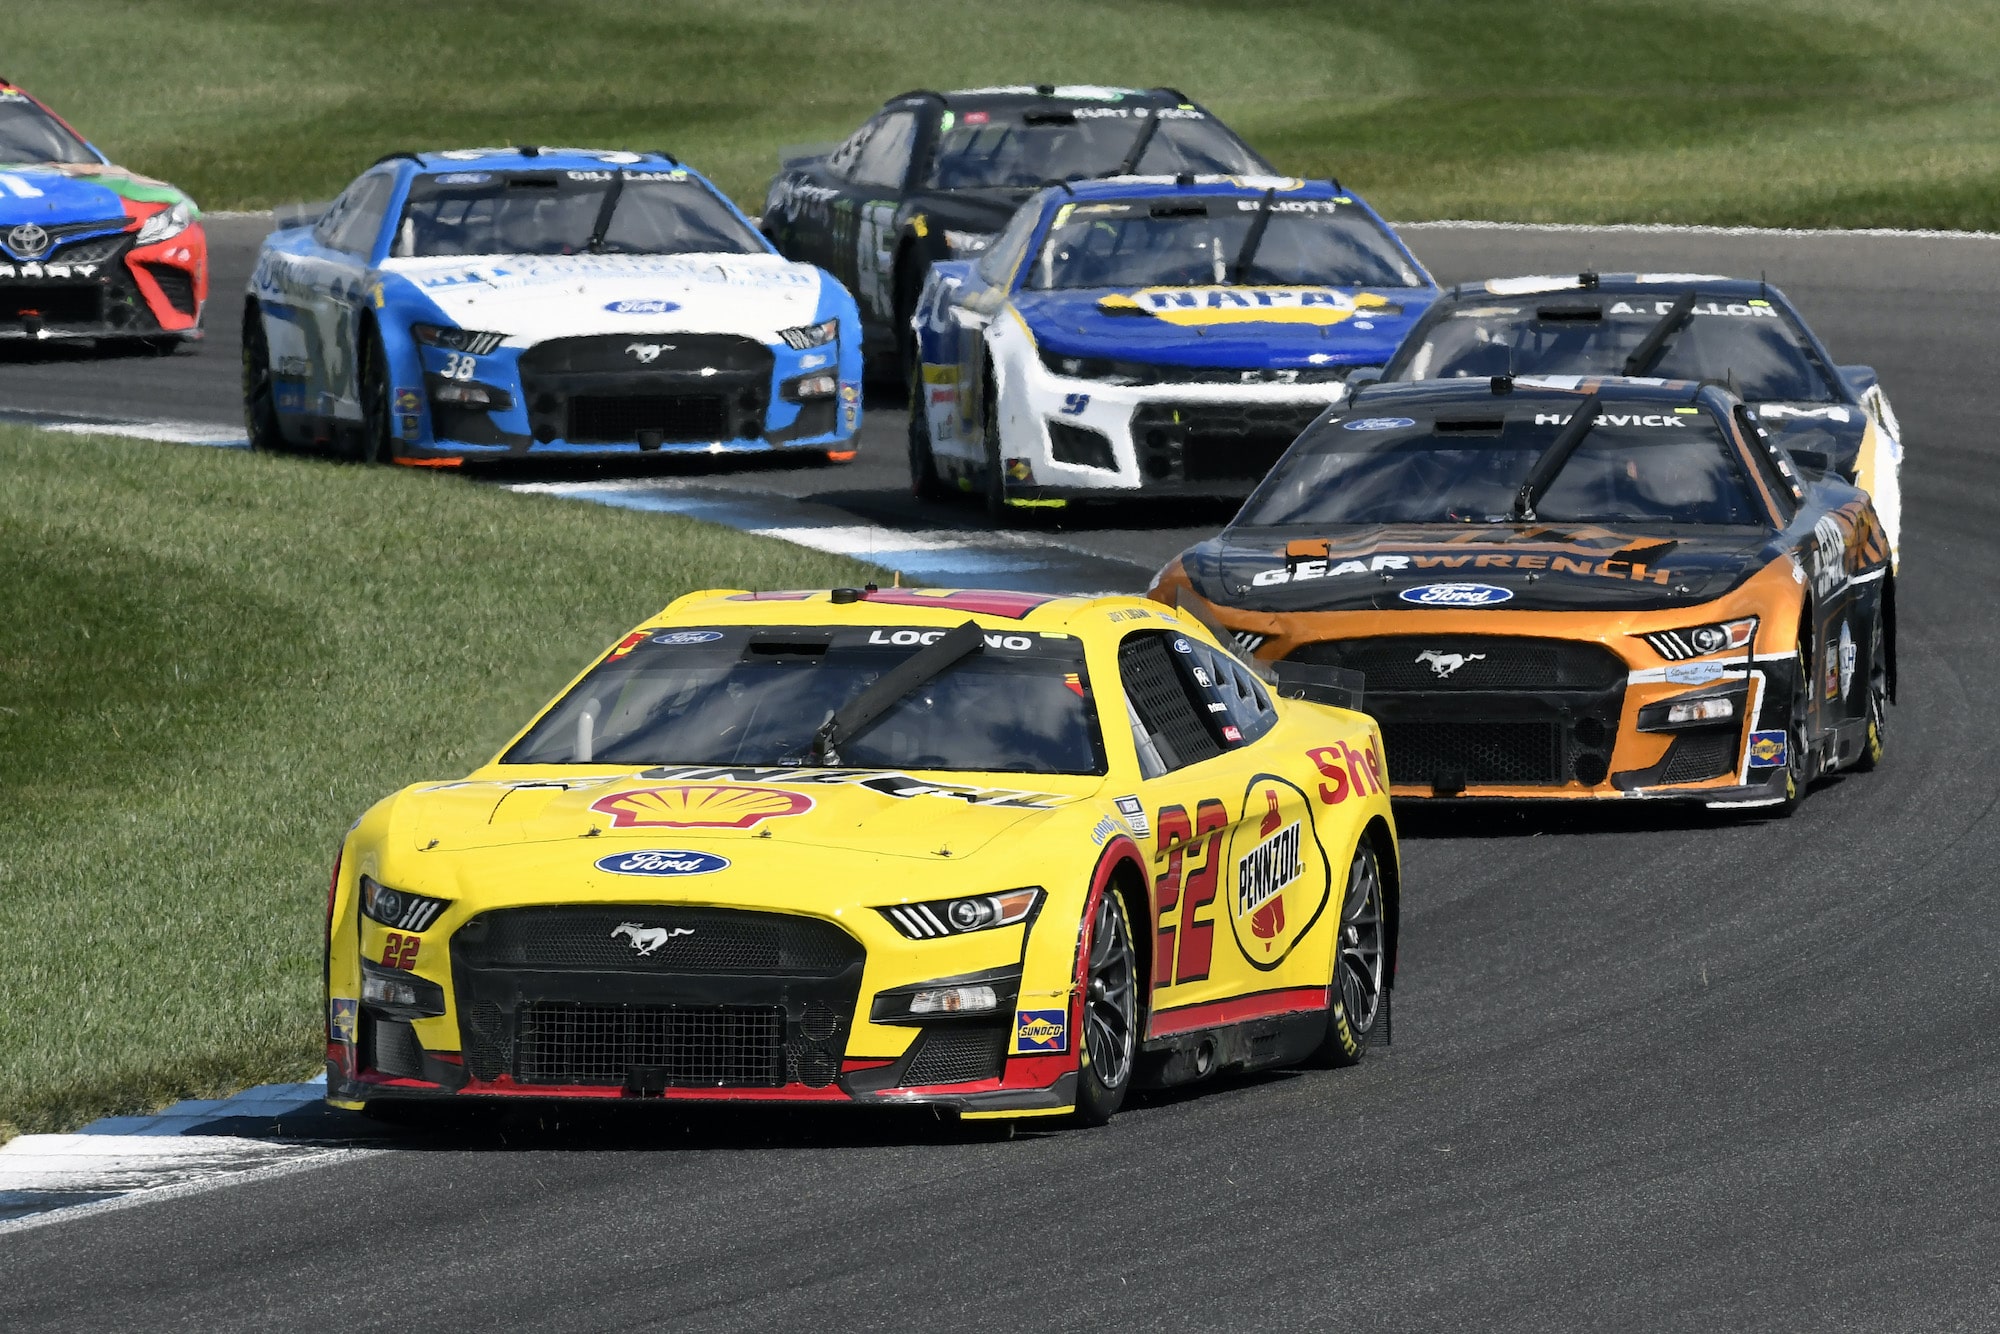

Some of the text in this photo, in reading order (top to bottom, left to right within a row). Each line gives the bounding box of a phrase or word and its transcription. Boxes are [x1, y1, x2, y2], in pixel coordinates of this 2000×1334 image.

[1150, 290, 1340, 309] NAPA
[1655, 302, 1778, 317] DLLON
[440, 353, 476, 382] 38
[1061, 393, 1090, 416] 9
[1252, 555, 1671, 587] GEARWRENCH
[868, 630, 1032, 651] LOGNO
[619, 851, 705, 872] Ford
[1238, 822, 1301, 918] PENNZOIL
[1154, 798, 1229, 988] 22
[382, 932, 421, 971] 22
[1020, 1024, 1062, 1037] SUNOCO
